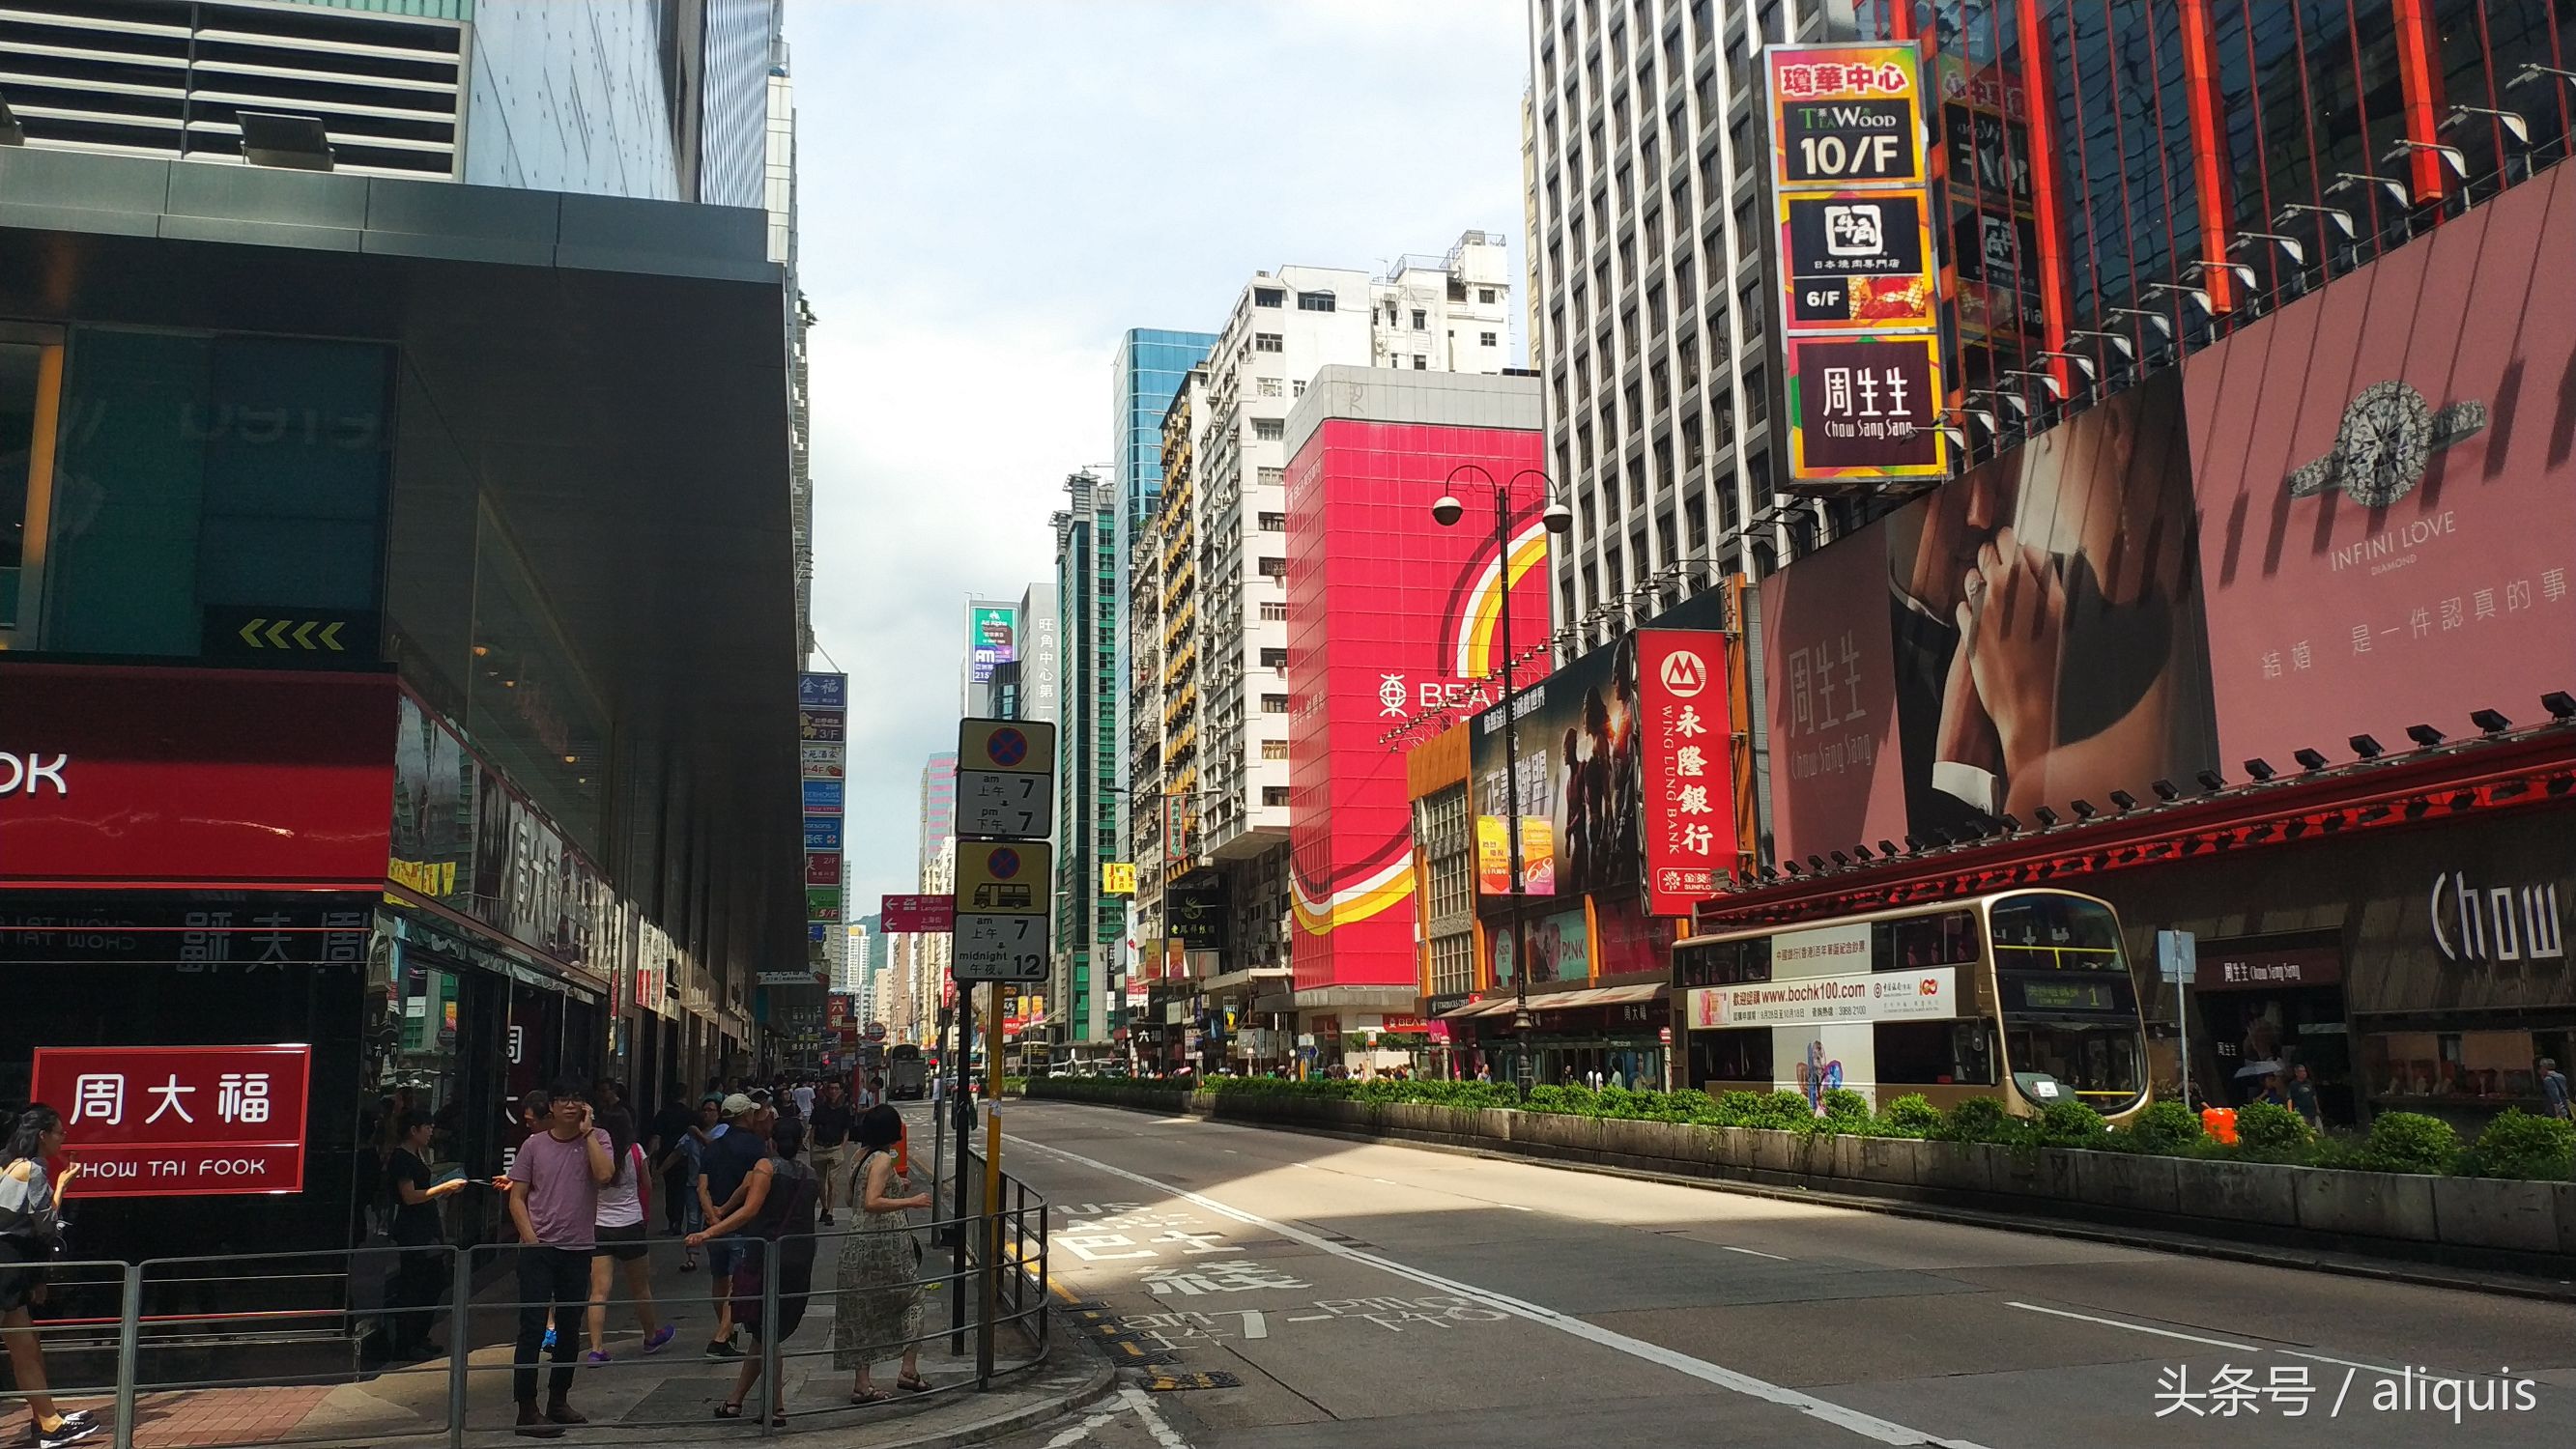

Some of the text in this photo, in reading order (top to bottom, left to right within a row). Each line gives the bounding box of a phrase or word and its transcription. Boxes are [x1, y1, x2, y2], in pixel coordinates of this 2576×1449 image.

[1801, 136, 1898, 175] 10/F
[1834, 214, 1876, 244] 牛角
[1807, 291, 1840, 307] 6/F
[1823, 367, 1911, 416] 周生生
[1824, 420, 1855, 438] Chow
[1857, 419, 1884, 440] Sang
[2331, 511, 2456, 572] INFINI LOVE
[2371, 554, 2417, 576] DIAMOND
[2261, 568, 2566, 679] 結婚 是一件認真的事
[1789, 630, 1867, 738] 周生生
[1791, 733, 1872, 780] Chow Sang Sang
[978, 786, 1004, 797] 上午
[1019, 779, 1034, 798] 7
[1662, 705, 1679, 854] WING LUNG BANK
[1674, 704, 1714, 856] 永隆銀行
[977, 819, 1003, 831] 下午
[982, 808, 1033, 832] pm 7
[1527, 857, 1553, 882] 68
[2431, 871, 2563, 961] Chow
[971, 928, 997, 939] 上午
[1015, 920, 1029, 940] 7
[959, 952, 1041, 976] midnight 12
[2224, 962, 2248, 981] 周生生
[1761, 981, 1866, 1003] www.bochk100.com
[2088, 987, 2100, 1006] 1
[70, 1073, 270, 1125] 周大福
[75, 1158, 266, 1178] HOW TAI FOOK
[1052, 1230, 1246, 1262] 巴士
[1207, 1309, 1268, 1339] 7
